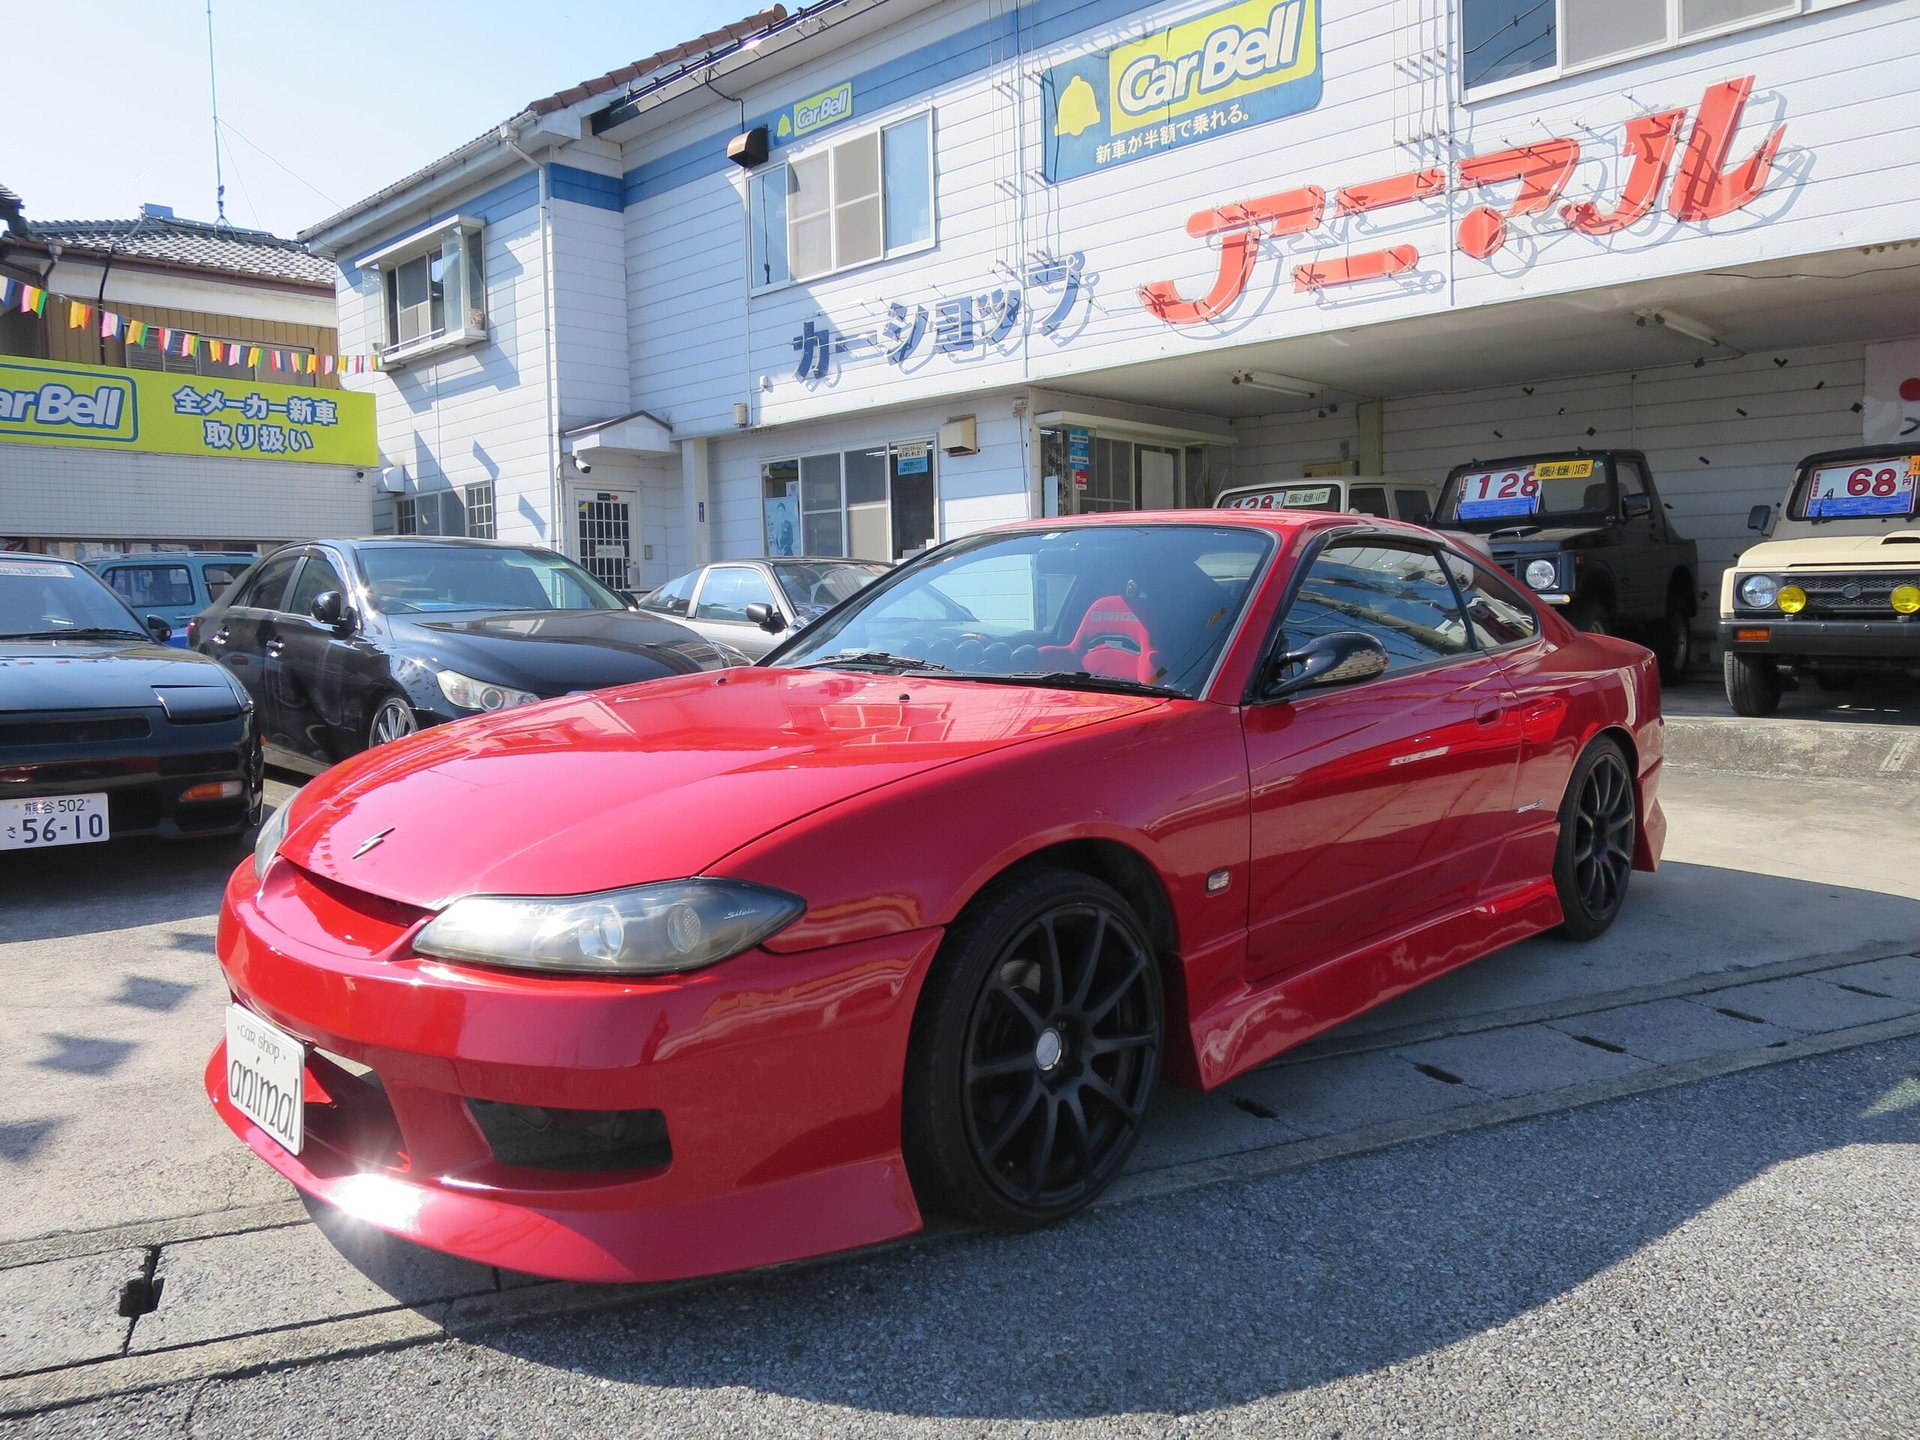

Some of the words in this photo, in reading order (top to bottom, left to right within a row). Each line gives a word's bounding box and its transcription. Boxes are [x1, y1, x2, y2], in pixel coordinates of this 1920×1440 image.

[1095, 104, 1249, 164] 新車が半額で乗れる。
[1139, 75, 1787, 324] アニマル
[172, 384, 338, 425] 全メーカー新車
[203, 420, 314, 453] 取り扱い
[1478, 471, 1540, 499] 128
[1846, 467, 1897, 496] 68
[24, 801, 55, 815] 熊谷
[57, 799, 85, 813] 502
[6, 826, 16, 839] さ
[22, 813, 103, 844] 56-10
[239, 1024, 257, 1044] car
[257, 1035, 281, 1064] shop
[230, 1057, 299, 1143] animal
